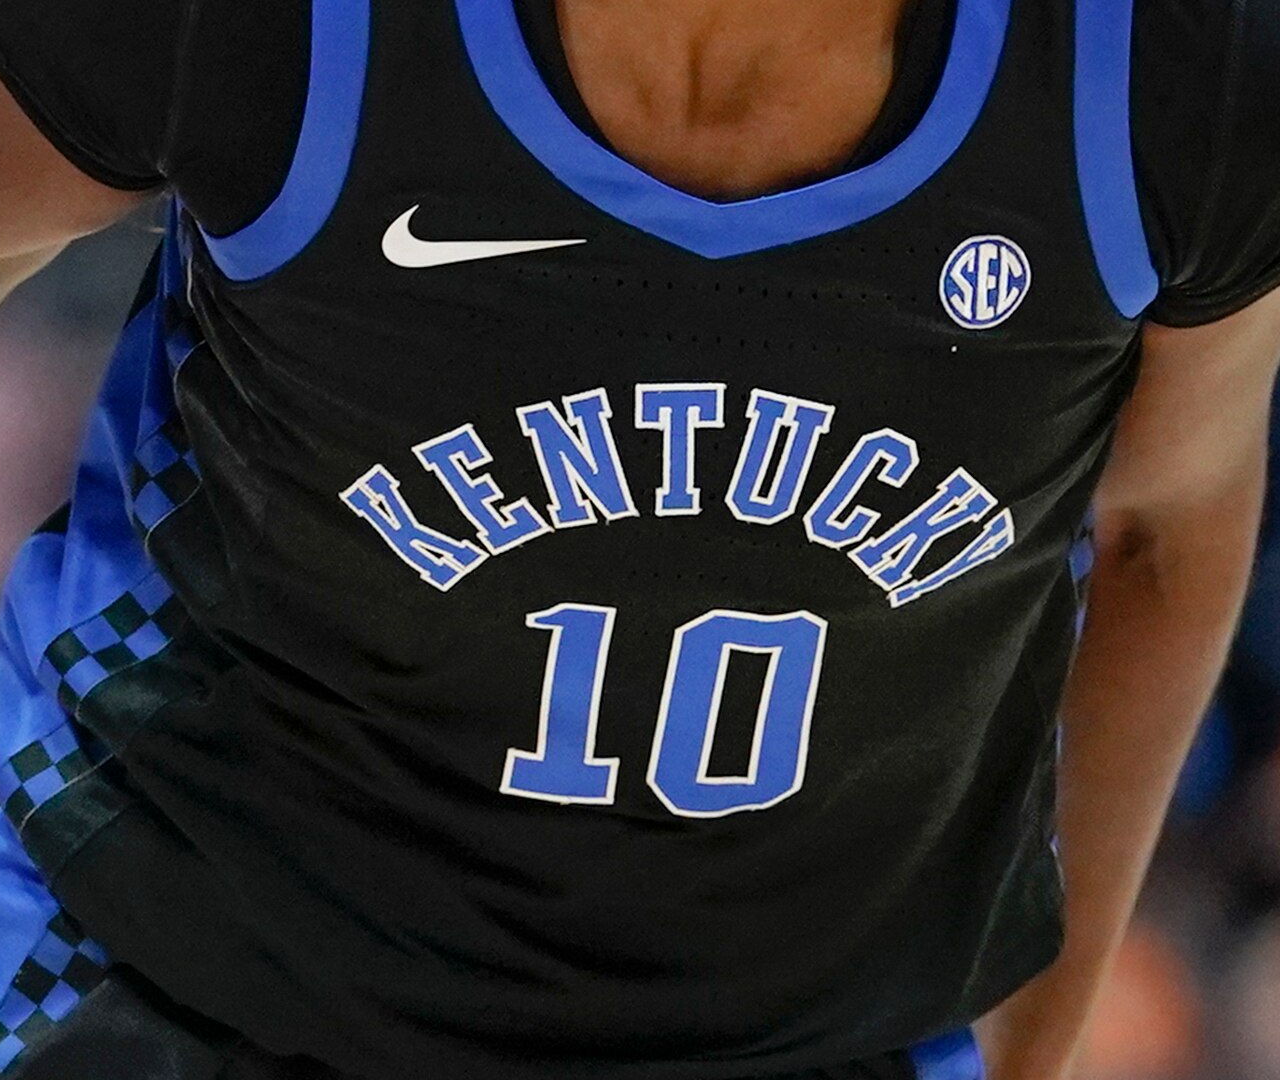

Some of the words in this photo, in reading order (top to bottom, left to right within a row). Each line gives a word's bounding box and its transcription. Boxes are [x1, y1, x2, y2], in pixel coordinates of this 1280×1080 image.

[950, 242, 1023, 321] SEC
[339, 383, 1014, 608] KENTUCKY
[500, 602, 827, 818] 10
